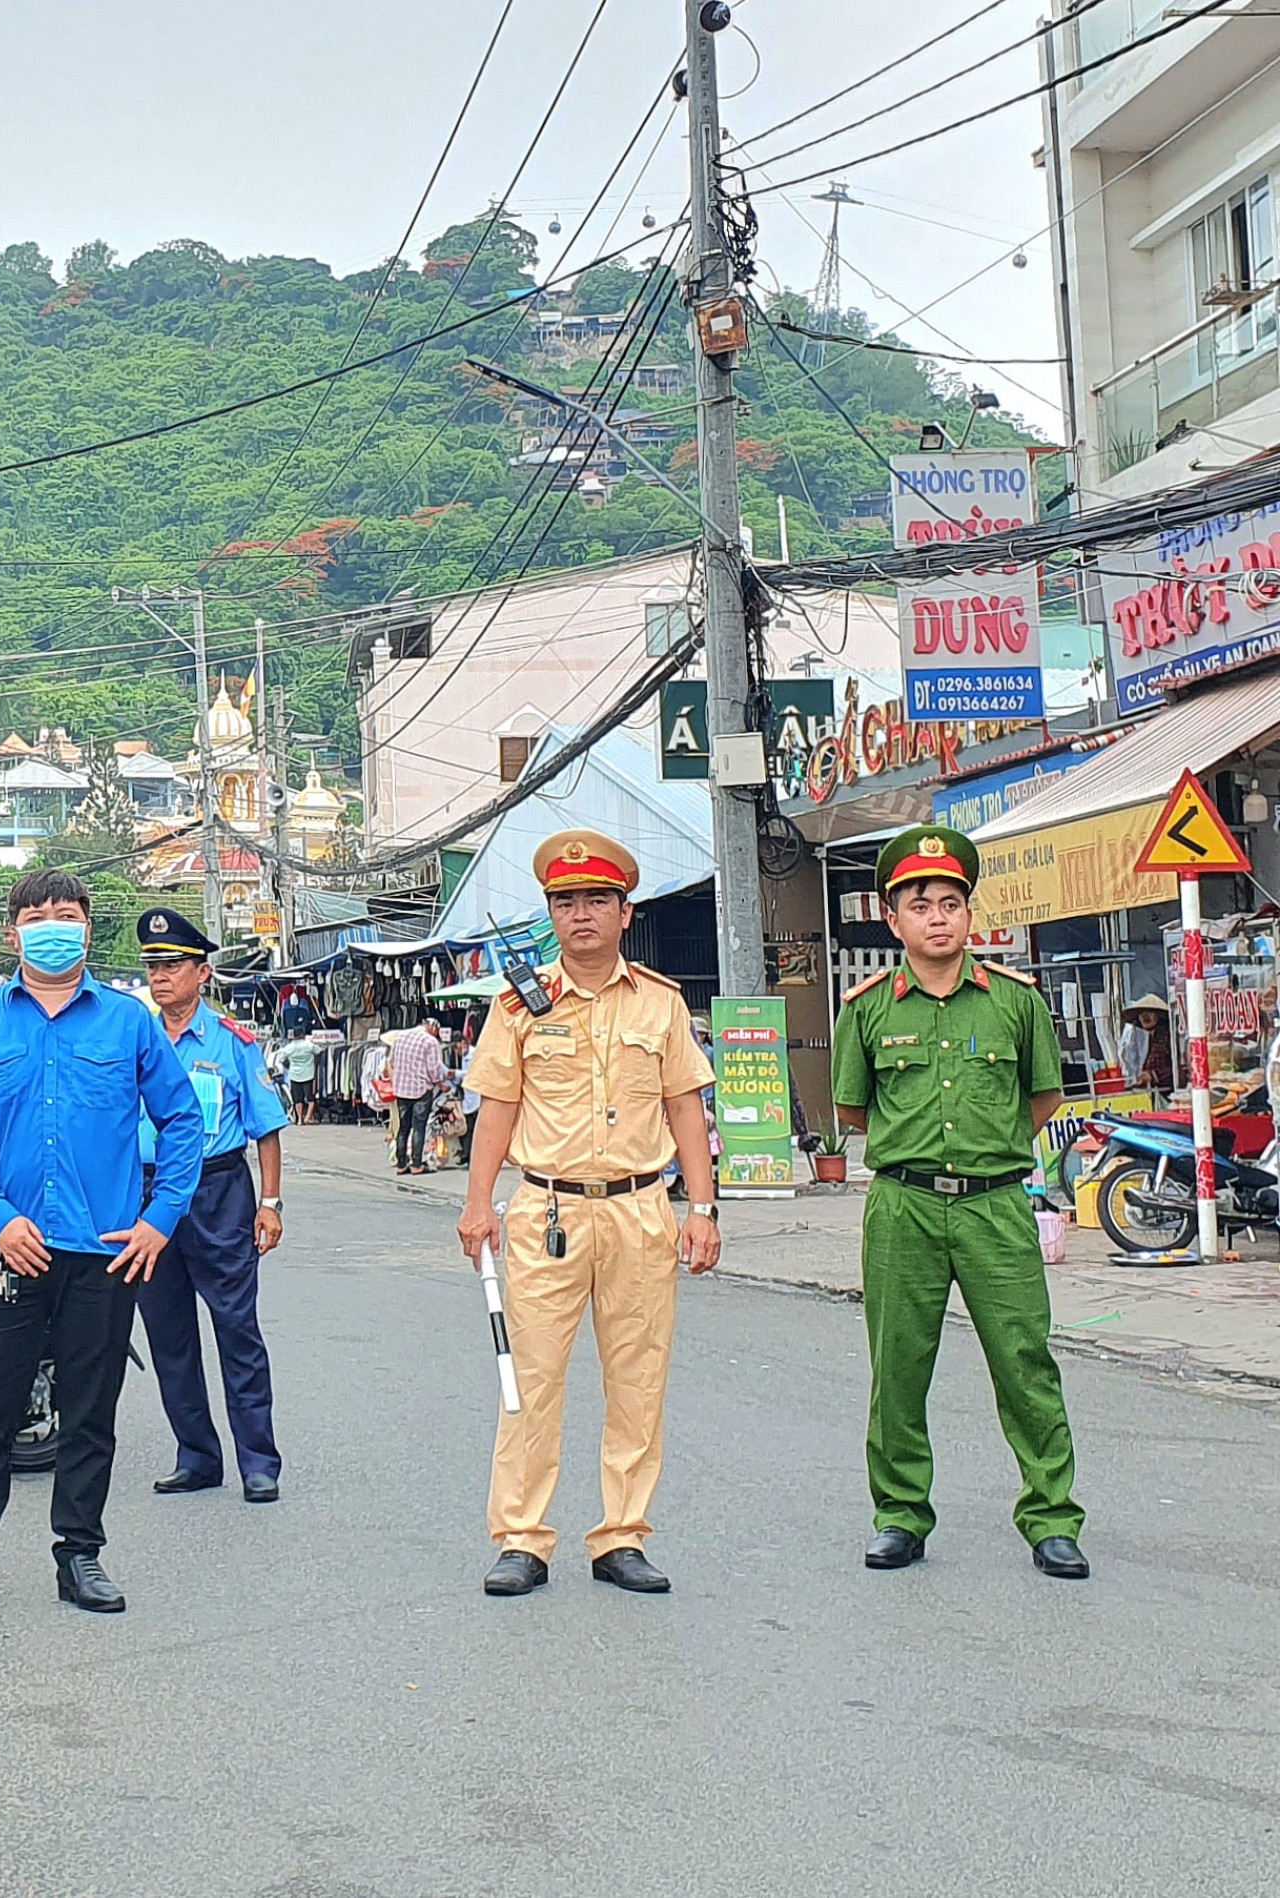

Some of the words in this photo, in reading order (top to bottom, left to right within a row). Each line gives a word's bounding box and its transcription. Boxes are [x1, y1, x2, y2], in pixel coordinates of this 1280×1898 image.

[898, 461, 975, 495] PHÒNG
[979, 467, 1027, 500] TRỌ
[911, 596, 1029, 655] DUNG
[937, 675, 1033, 692] 0296.3861634
[938, 695, 1025, 713] 0913664267
[754, 1052, 778, 1062] TRA
[724, 1062, 757, 1079] MẬT
[758, 1062, 780, 1080] ĐỘ
[720, 1079, 785, 1095] XƯƠNG
